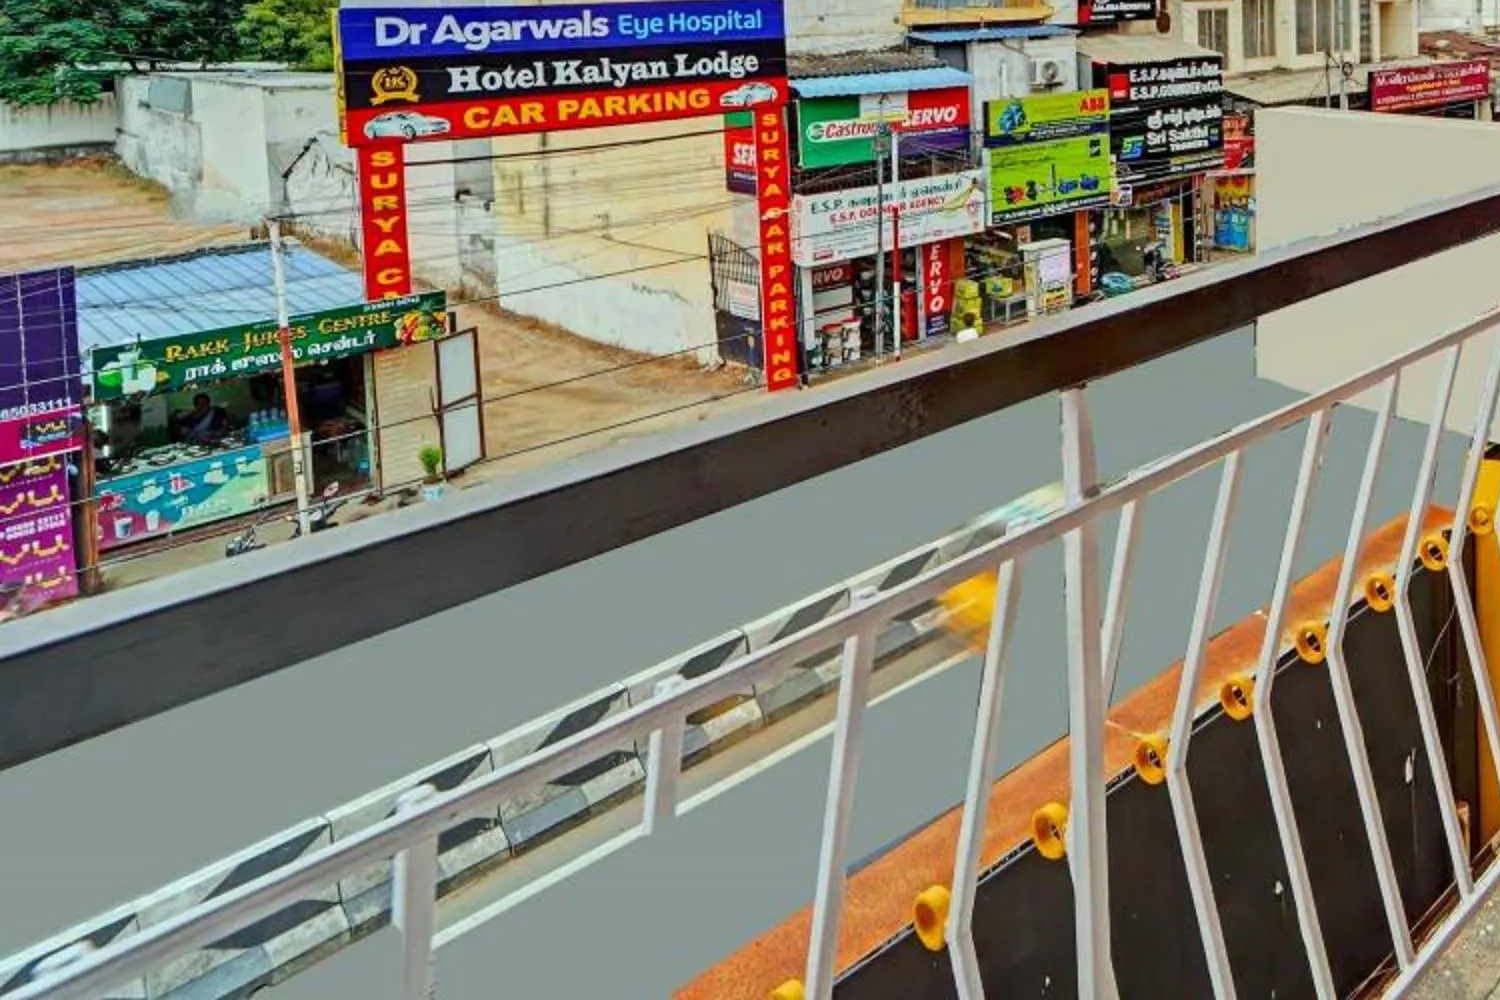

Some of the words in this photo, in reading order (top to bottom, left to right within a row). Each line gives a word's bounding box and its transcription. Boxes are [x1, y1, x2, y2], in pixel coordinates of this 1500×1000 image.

[375, 16, 426, 47] Dr
[431, 9, 609, 51] Agarwals
[618, 14, 664, 39] Eye
[669, 9, 762, 36] Hospital
[446, 61, 547, 93] Hotel
[553, 57, 670, 88] Kalyan
[673, 50, 759, 78] Lodge
[463, 102, 546, 130] CAR
[558, 88, 711, 122] PARKING
[824, 120, 876, 138] Castro
[761, 113, 782, 197] SURYA
[370, 151, 403, 257] SURYA
[165, 338, 230, 362] RAKK
[318, 309, 392, 334] CENTRE
[768, 265, 793, 382] PARKING
